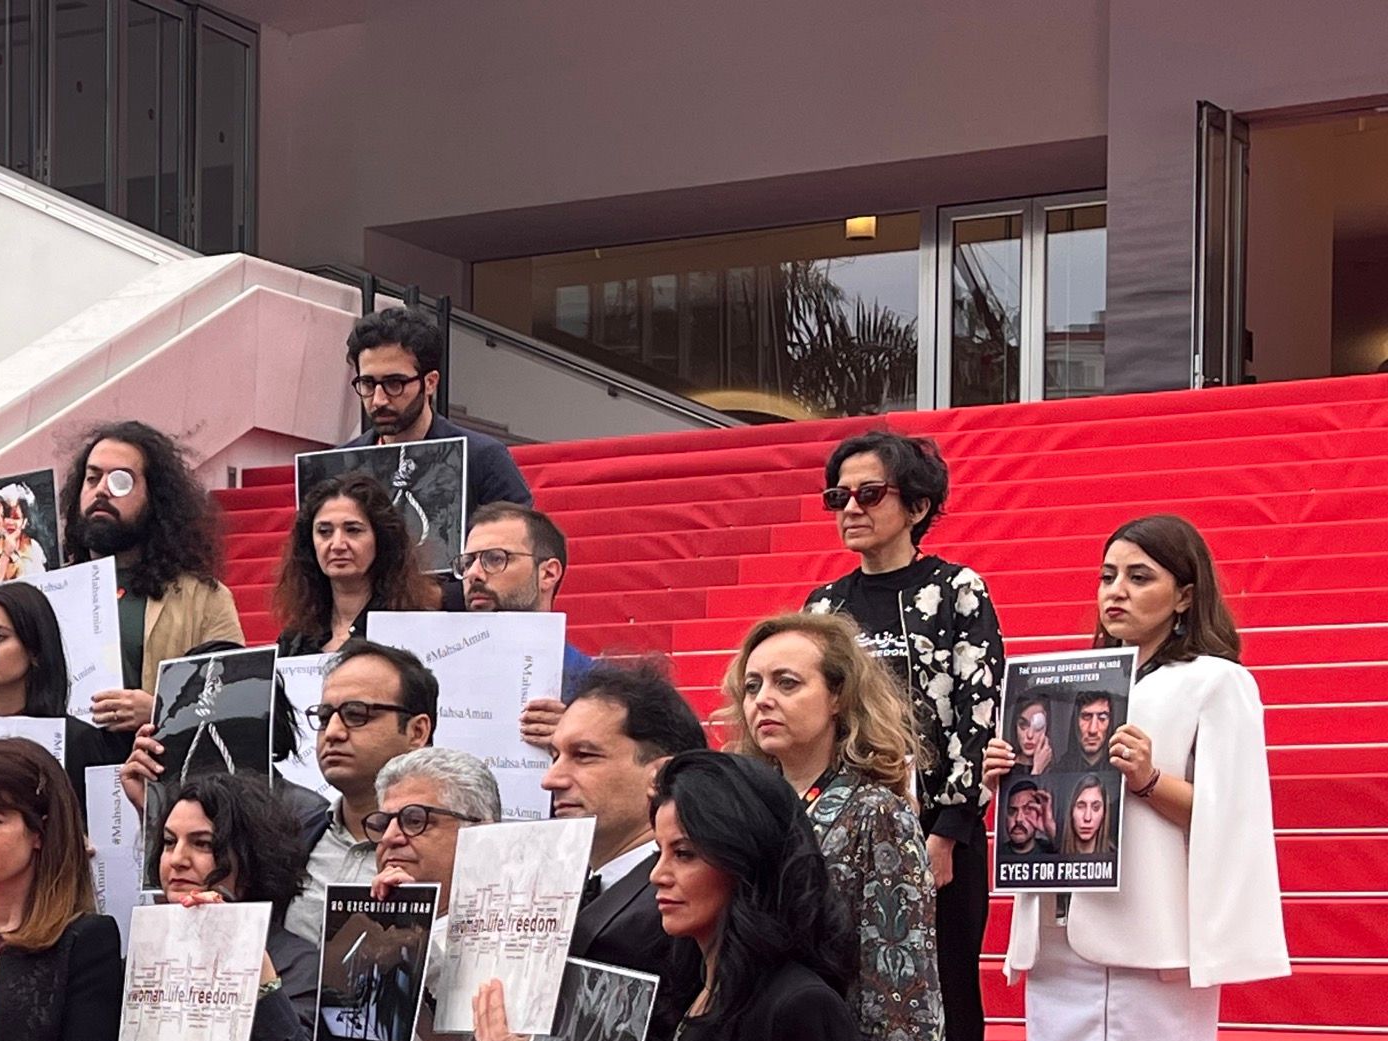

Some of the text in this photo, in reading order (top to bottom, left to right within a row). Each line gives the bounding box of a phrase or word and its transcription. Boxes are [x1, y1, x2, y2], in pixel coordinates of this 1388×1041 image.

[426, 630, 490, 664] #MahsaAmini
[1000, 862, 1113, 881] EYES FOR FREEDOM
[331, 900, 432, 914] NO EXECUTION IN IRAN
